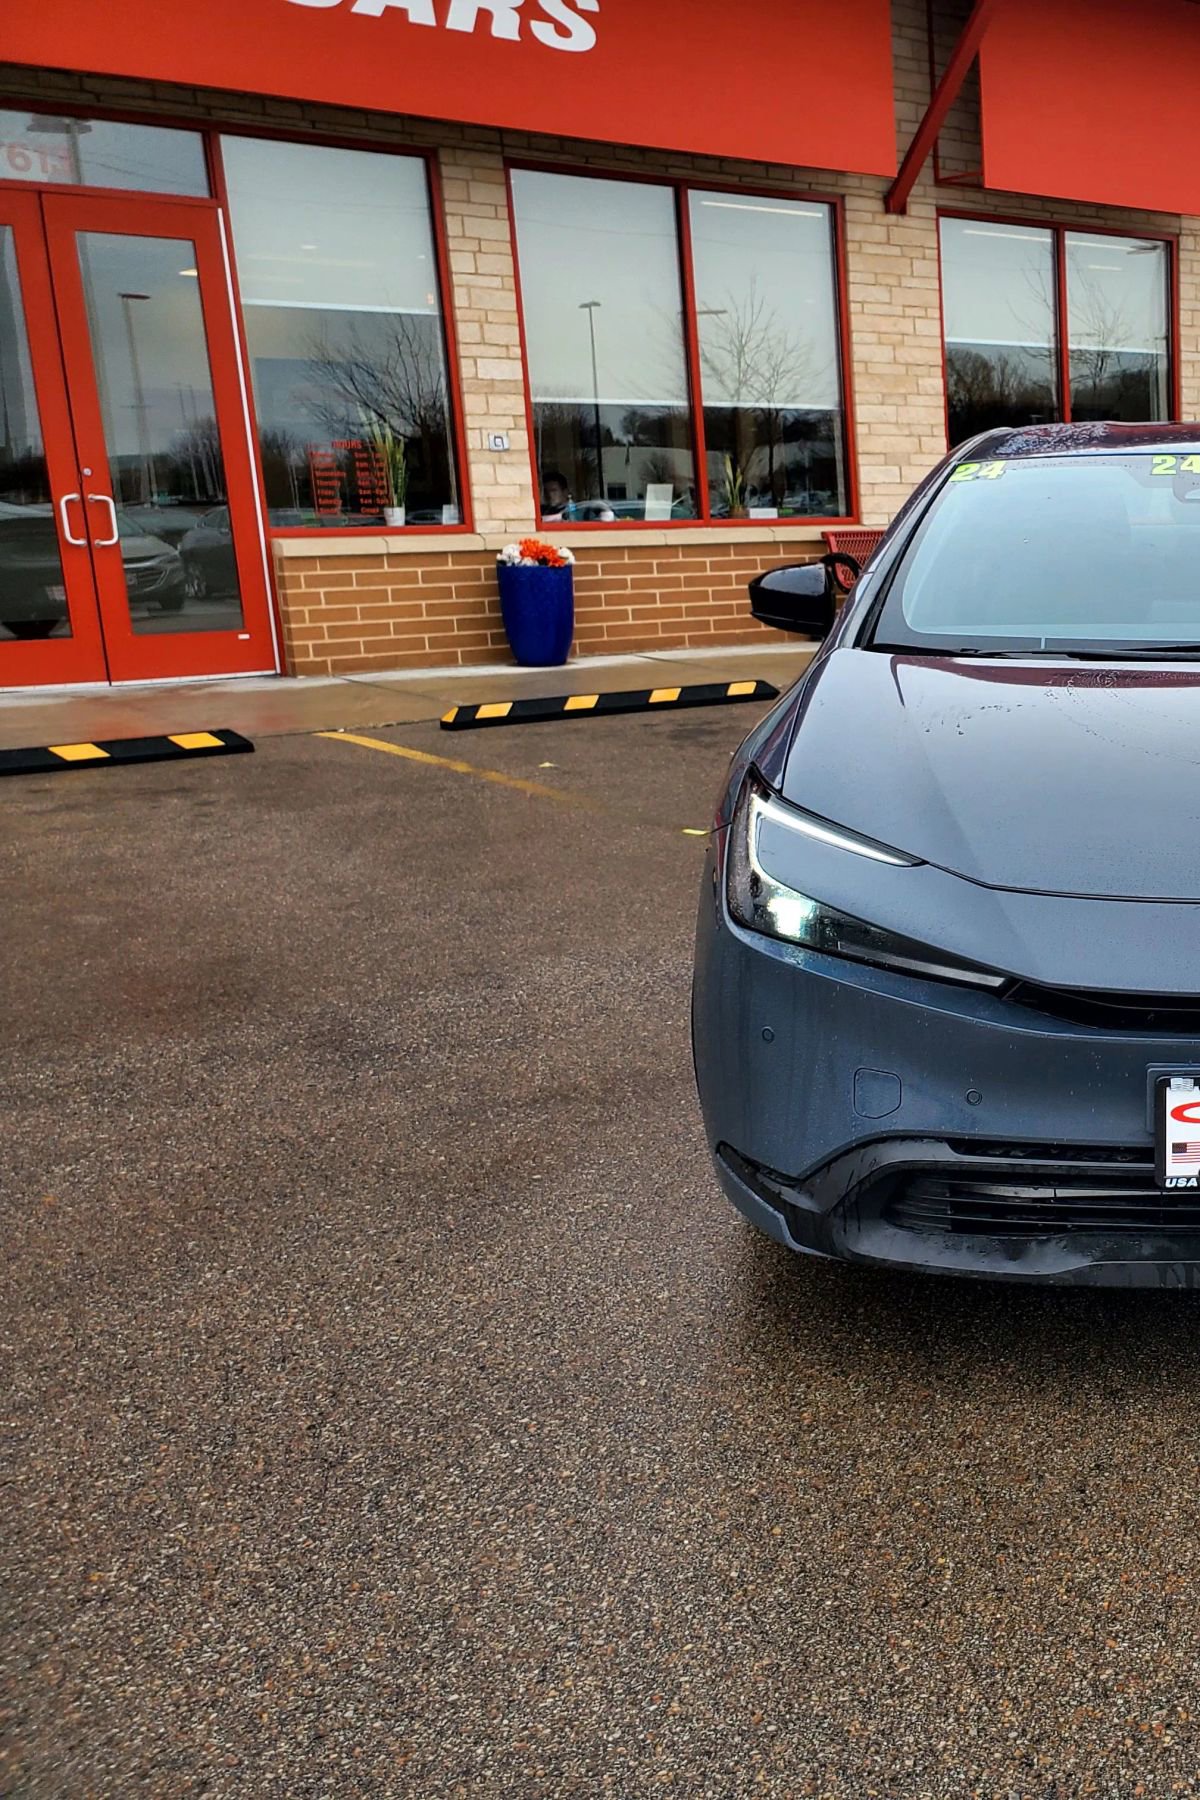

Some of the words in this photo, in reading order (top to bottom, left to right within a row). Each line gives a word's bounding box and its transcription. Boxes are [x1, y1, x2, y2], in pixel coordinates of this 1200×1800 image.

[285, 0, 600, 52] RS
[949, 461, 1007, 481] 24
[1165, 1176, 1198, 1188] USA
